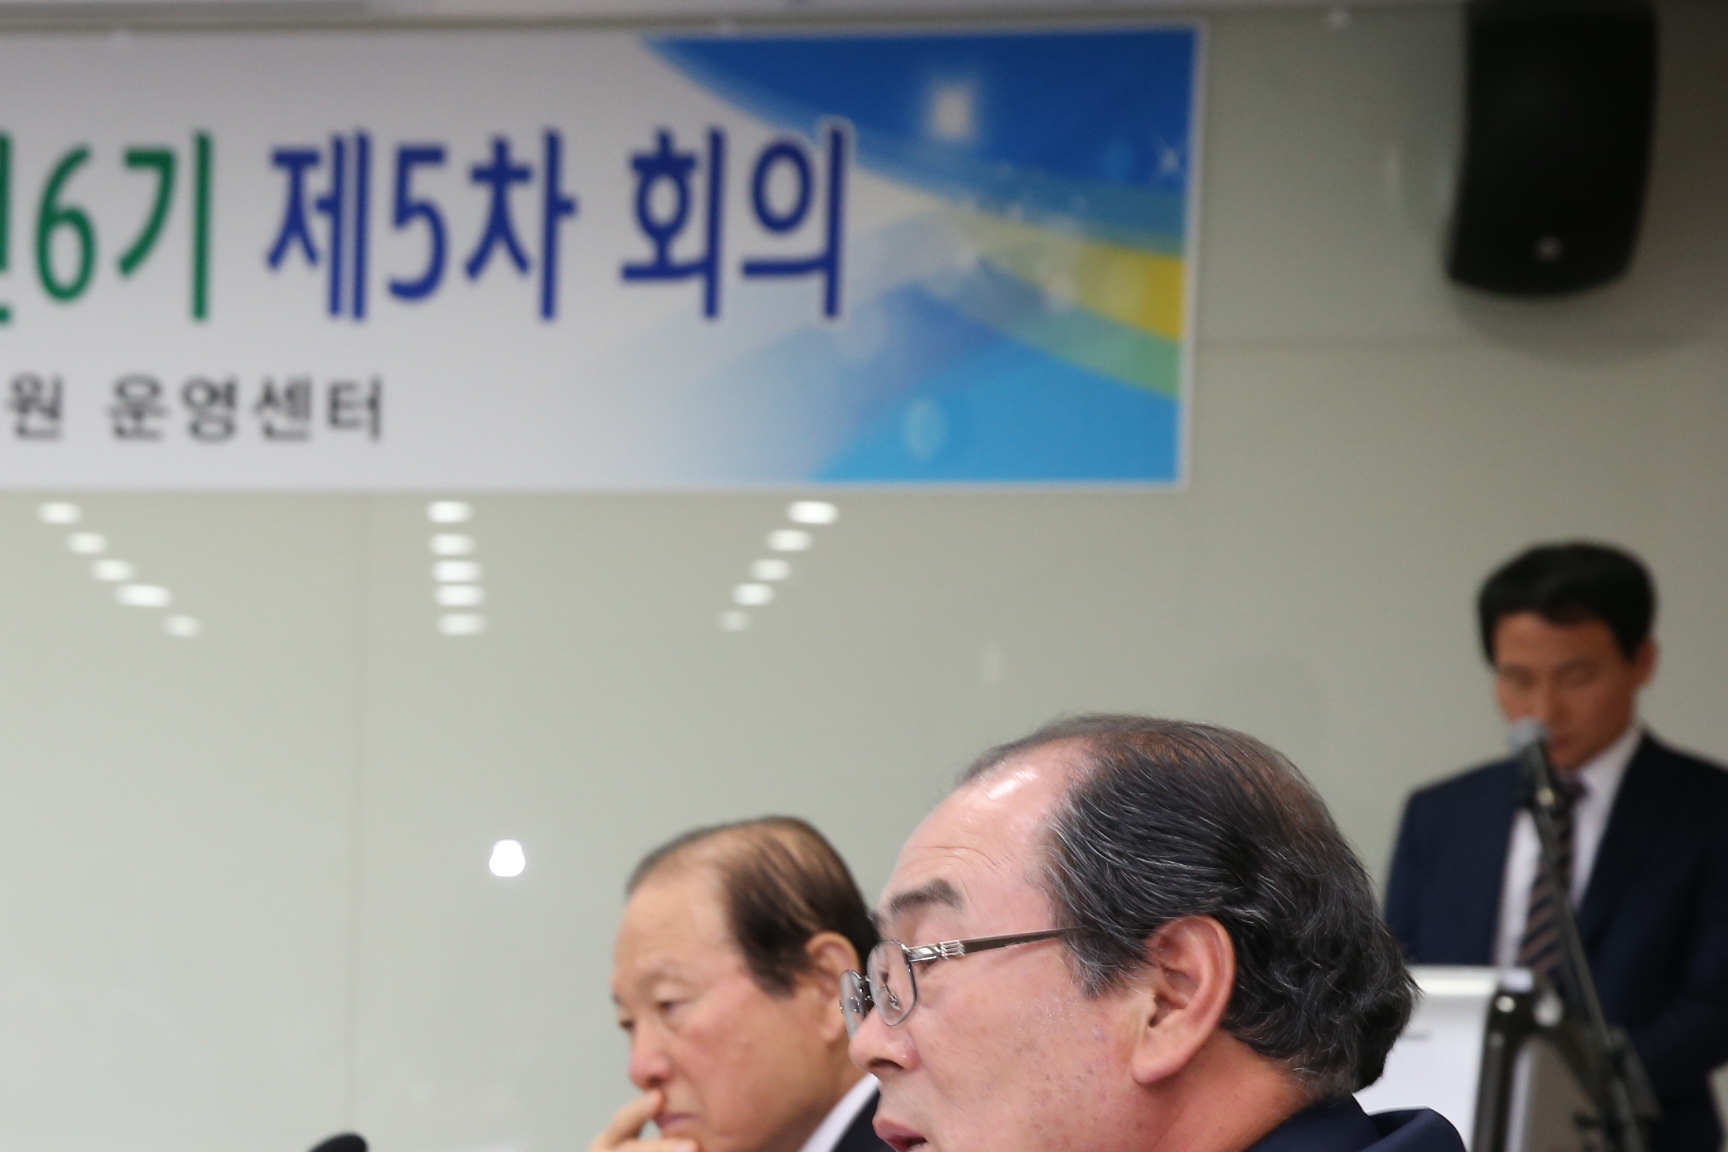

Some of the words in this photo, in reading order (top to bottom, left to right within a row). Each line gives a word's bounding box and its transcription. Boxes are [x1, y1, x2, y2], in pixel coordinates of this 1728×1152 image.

[264, 126, 578, 322] 제5차
[619, 122, 849, 321] 회의
[106, 372, 382, 444] 운영센터
